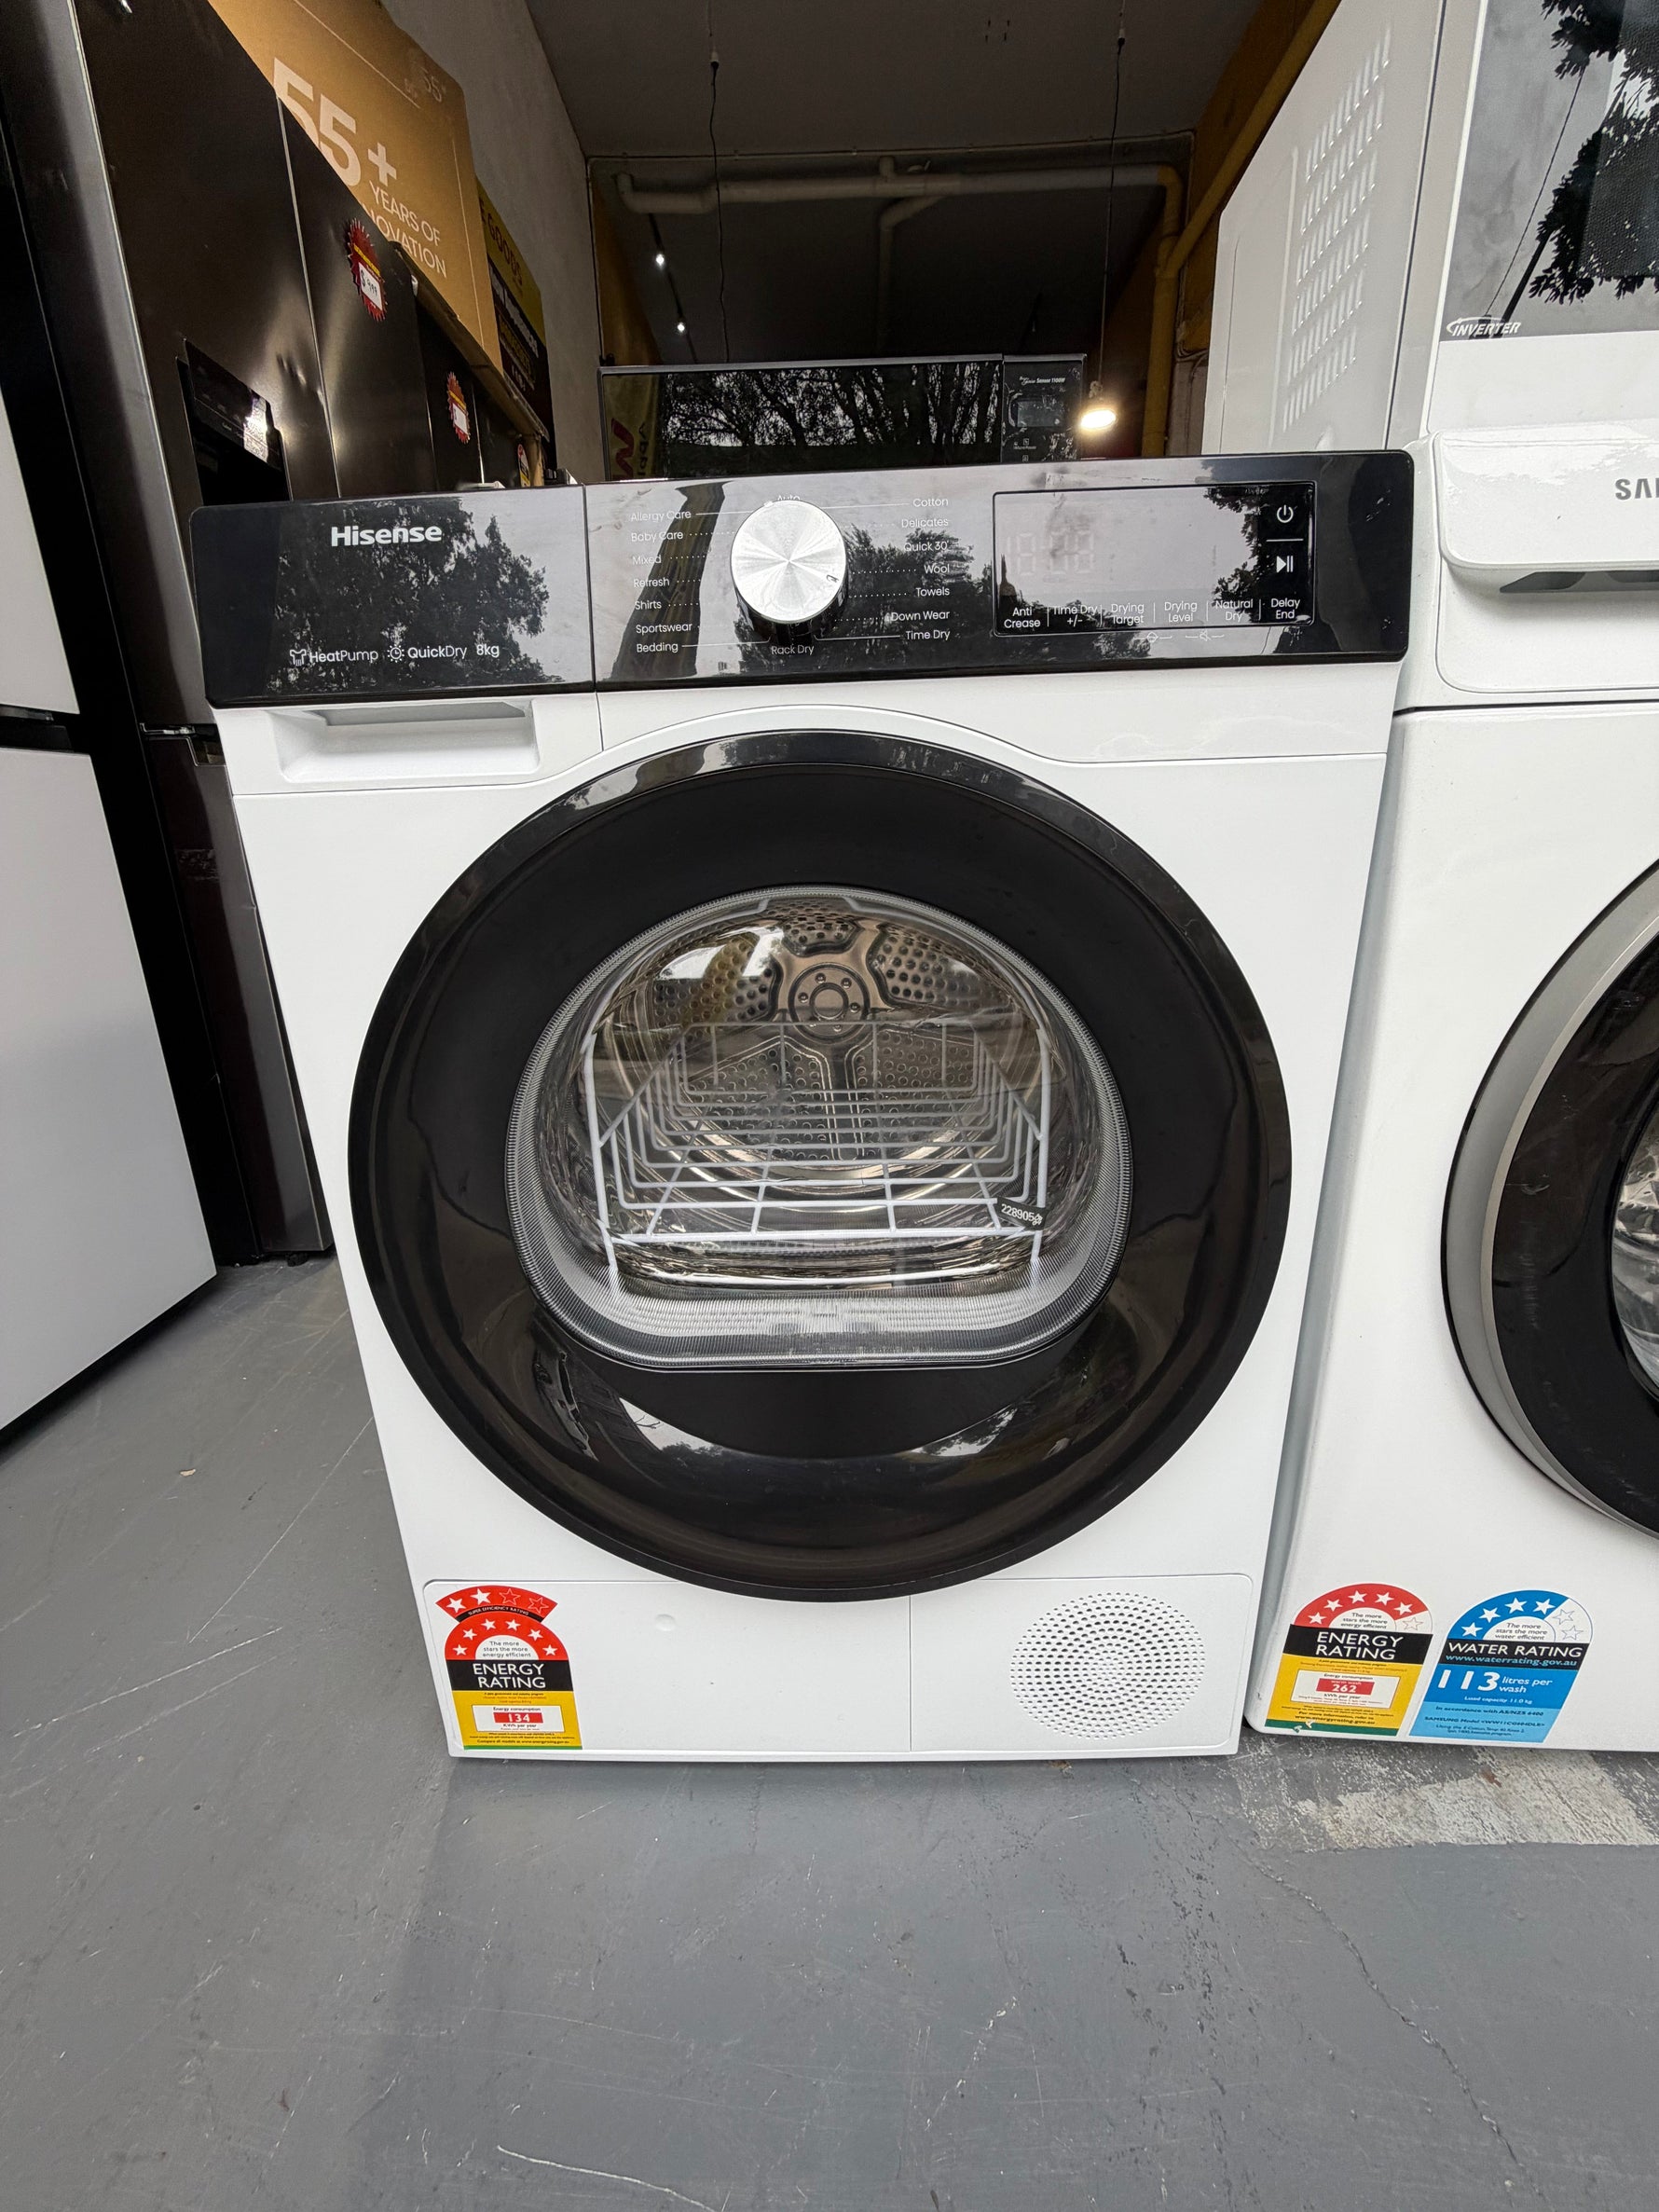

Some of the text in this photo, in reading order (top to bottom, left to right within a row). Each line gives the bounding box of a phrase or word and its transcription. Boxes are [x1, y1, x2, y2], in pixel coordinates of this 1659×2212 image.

[369, 180, 441, 246] YEARS OF
[362, 202, 447, 278] OVATION
[1451, 322, 1521, 337] INVERTER
[913, 498, 949, 507] Cotton
[631, 511, 692, 522] Allergy Care
[901, 518, 949, 528] Delicates
[331, 526, 443, 547] Hisense
[631, 531, 683, 543] Baby Care
[904, 542, 932, 552] Quick
[632, 555, 662, 565] Mixed
[924, 563, 950, 574] Wool
[634, 577, 670, 587] Refresh
[915, 586, 951, 597] Towels
[635, 600, 662, 611] Shirts
[1111, 602, 1145, 614] Drying
[1164, 600, 1198, 612] Drying
[1214, 598, 1254, 610] Natural
[1270, 598, 1301, 610] Delay
[1012, 607, 1033, 617] Anti
[1053, 605, 1098, 616] Time Dry
[1276, 609, 1296, 620] End
[891, 611, 951, 622] Down Wear
[1112, 615, 1145, 626] Target
[1168, 612, 1194, 623] Level
[1226, 611, 1242, 623] Dry
[1004, 619, 1041, 628] Crease
[636, 623, 693, 636] Sportswear
[906, 629, 951, 641] Time Dry
[637, 642, 679, 653] Bedding
[771, 644, 815, 656] Rack Dry
[308, 644, 500, 663] HeatPump QuickDry 8kg
[468, 1608, 482, 1616] SUPER
[1317, 1631, 1404, 1648] ENERGY
[1315, 1644, 1396, 1660] RATING
[1448, 1642, 1584, 1658] WATER RATING
[1445, 1655, 1577, 1667] www.waterrating.gov.au
[473, 1663, 544, 1675] ENERGY
[478, 1677, 546, 1689] RATING
[1438, 1669, 1553, 1692] 113 litres per
[1332, 1683, 1357, 1693] 262
[1499, 1685, 1527, 1694] wash
[509, 1713, 530, 1723] 134
